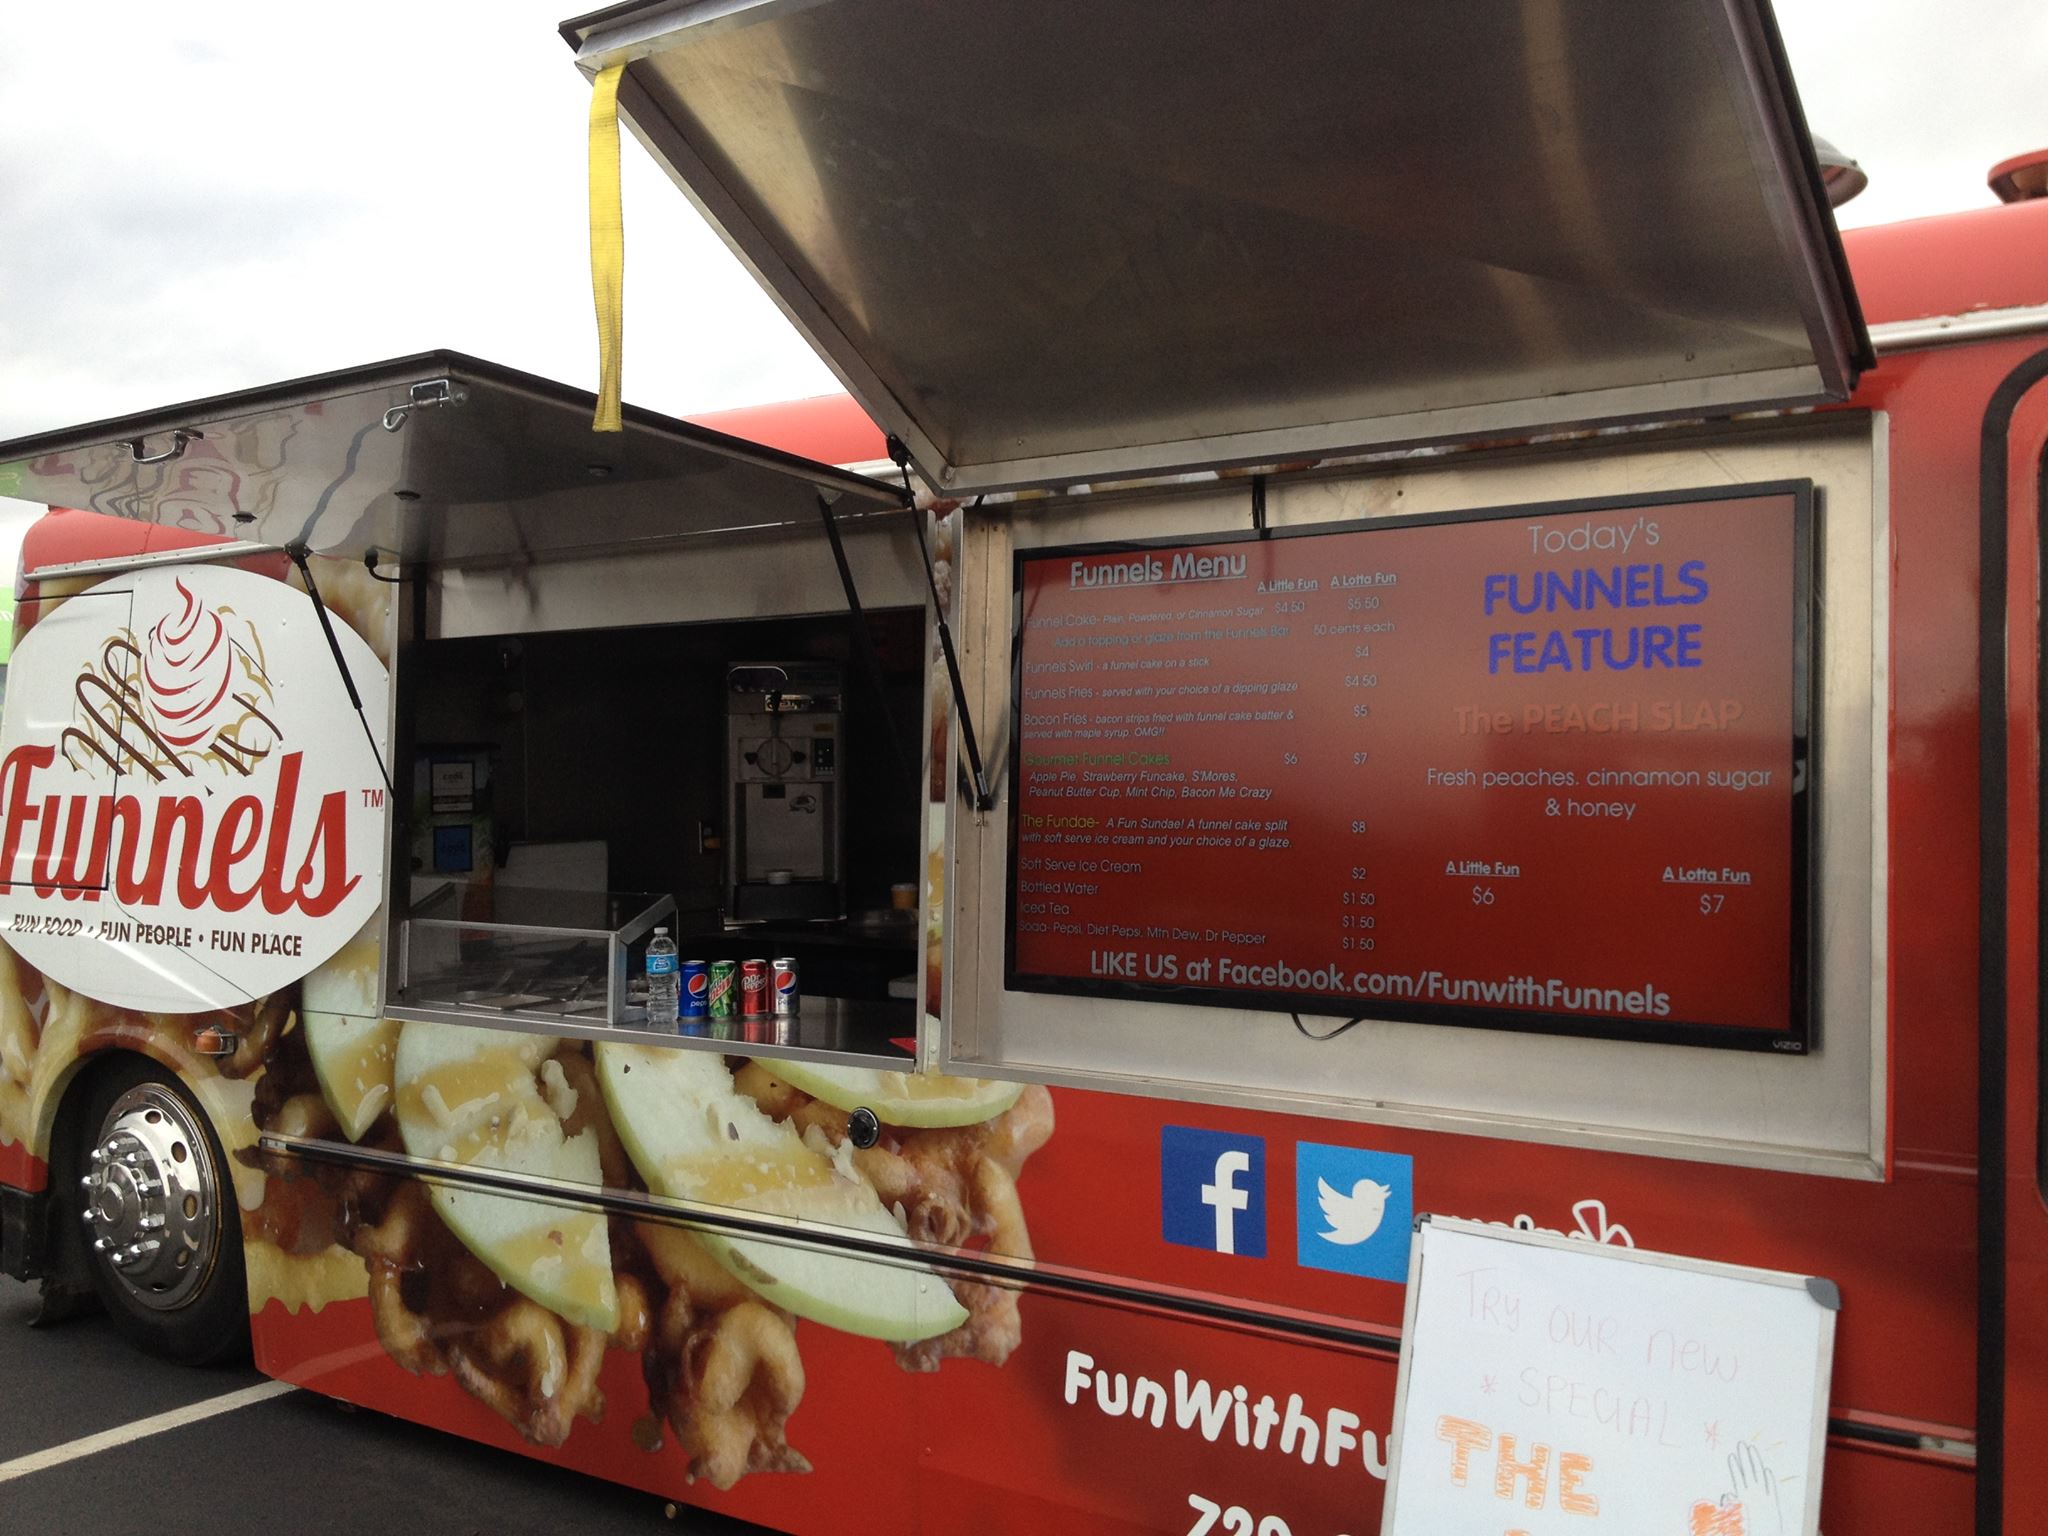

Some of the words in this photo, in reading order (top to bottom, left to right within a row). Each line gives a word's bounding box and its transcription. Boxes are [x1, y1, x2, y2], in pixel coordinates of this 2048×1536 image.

[1528, 517, 1660, 554] Today's
[1070, 555, 1164, 588] Funnels
[1171, 552, 1248, 581] Menu
[1257, 582, 1267, 592] A
[1270, 579, 1295, 592] Little
[1298, 578, 1319, 591] Fun
[1331, 576, 1341, 587] A
[1343, 573, 1372, 586] Lotta
[1375, 571, 1397, 585] Fun
[1484, 560, 1710, 617] FUNNELS
[1176, 612, 1186, 621] or
[1188, 607, 1233, 620] Cinnamon
[1235, 605, 1265, 619] Sugar
[1313, 624, 1327, 637] 50
[1329, 621, 1361, 635] cents
[1364, 619, 1396, 633] each
[1088, 633, 1129, 648] topping
[1132, 634, 1143, 644] or
[1145, 632, 1174, 646] glaze
[1176, 629, 1203, 641] from
[1204, 627, 1224, 640] the
[1354, 645, 1370, 658] $4
[1488, 623, 1704, 675] FEATURE
[1025, 660, 1067, 674] Funnels
[1109, 659, 1139, 671] funnel
[1140, 658, 1164, 670] cake
[1165, 659, 1177, 668] on
[1188, 656, 1210, 667] stick
[1025, 687, 1067, 700] Funnels
[1069, 686, 1093, 699] Fries
[1102, 685, 1133, 698] served
[1134, 685, 1154, 697] with
[1155, 686, 1177, 699] your
[1179, 683, 1210, 695] choice
[1212, 682, 1222, 694] of
[1232, 681, 1268, 696] dipping
[1271, 681, 1298, 695] glaze
[1024, 713, 1060, 726] Bacon
[1063, 712, 1088, 725] Fries
[1096, 712, 1123, 724] bacon
[1125, 712, 1150, 725] strips
[1152, 711, 1173, 723] fried
[1175, 710, 1194, 722] with
[1196, 710, 1226, 722] funnel
[1228, 709, 1252, 721] cake
[1254, 709, 1284, 721] batter
[1286, 709, 1294, 721] &
[1353, 703, 1368, 718] $5
[1454, 705, 1514, 736] The
[1522, 702, 1640, 735] PEACH
[1643, 699, 1745, 733] SLAP
[1024, 729, 1053, 739] served
[1054, 728, 1073, 738] with
[1074, 727, 1102, 740] maple
[1134, 726, 1166, 737] OMG!!
[1024, 752, 1079, 766] Gourmet
[1082, 751, 1125, 766] Funnel
[1128, 751, 1171, 765] Cakes
[1284, 752, 1298, 765] $6
[1353, 751, 1368, 765] $7
[1029, 771, 1057, 784] Apple
[1082, 770, 1137, 784] Strawberry
[1427, 768, 1475, 786] Fresh
[1586, 768, 1700, 787] cinnamon
[1706, 770, 1772, 791] sugar
[1029, 785, 1064, 797] Peanut
[1066, 785, 1096, 797] Butter
[1125, 785, 1148, 797] Mint
[1181, 786, 1215, 798] Bacon
[1218, 786, 1236, 798] Me
[1239, 786, 1273, 800] Crazy
[1545, 798, 1561, 817] &
[1567, 798, 1636, 821] honey
[0, 744, 363, 918] Funnels
[362, 789, 384, 808] TM
[1021, 814, 1043, 828] The
[1105, 817, 1115, 828] A
[1117, 817, 1138, 829] Fun
[1140, 817, 1184, 830] Sundae!
[1187, 818, 1196, 829] A
[1198, 818, 1231, 831] funnel
[1235, 819, 1261, 831] cake
[1264, 819, 1288, 833] split
[1351, 820, 1367, 834] $8
[1022, 832, 1041, 842] with
[1043, 831, 1062, 842] soft
[1064, 834, 1092, 844] serve
[1094, 833, 1109, 844] ice
[1112, 835, 1145, 845] cream
[1147, 834, 1167, 846] and
[1169, 835, 1194, 848] your
[1196, 835, 1232, 847] choice
[1235, 836, 1248, 848] of
[1020, 857, 1042, 871] Soft
[1044, 858, 1076, 872] Serve
[1079, 859, 1098, 872] Ice
[1100, 859, 1142, 873] Cream
[1351, 866, 1367, 880] $2
[1446, 861, 1456, 873] A
[1460, 861, 1491, 874] Little
[1495, 862, 1520, 875] Fun
[1663, 866, 1674, 880] A
[1679, 867, 1717, 882] Lotta
[1720, 868, 1751, 883] Fun
[1020, 880, 1061, 894] Bottled
[1063, 881, 1100, 895] Water
[1472, 886, 1495, 906] $6
[1020, 901, 1046, 914] Iced
[1049, 902, 1070, 915] Tea
[1700, 893, 1725, 916] $7
[9, 914, 41, 931] FUN
[43, 917, 84, 937] FOOD
[95, 921, 131, 943] FUN
[136, 923, 192, 947] PEOPLE
[211, 930, 245, 952] FUN
[251, 932, 303, 957] PLACE
[1087, 922, 1109, 935] Diet
[1147, 926, 1169, 939] Mtn
[1205, 929, 1218, 942] Dr
[1221, 930, 1267, 946] Pepper
[1091, 949, 1137, 977] LIKE
[1145, 952, 1179, 980] US
[1186, 957, 1210, 982] at
[1218, 957, 1671, 1017] Facebook.com/FunwithFunnels
[1772, 1040, 1802, 1051] VIZIO
[1517, 1366, 1683, 1450] SPECIAL
[1435, 1414, 1600, 1518] THE
